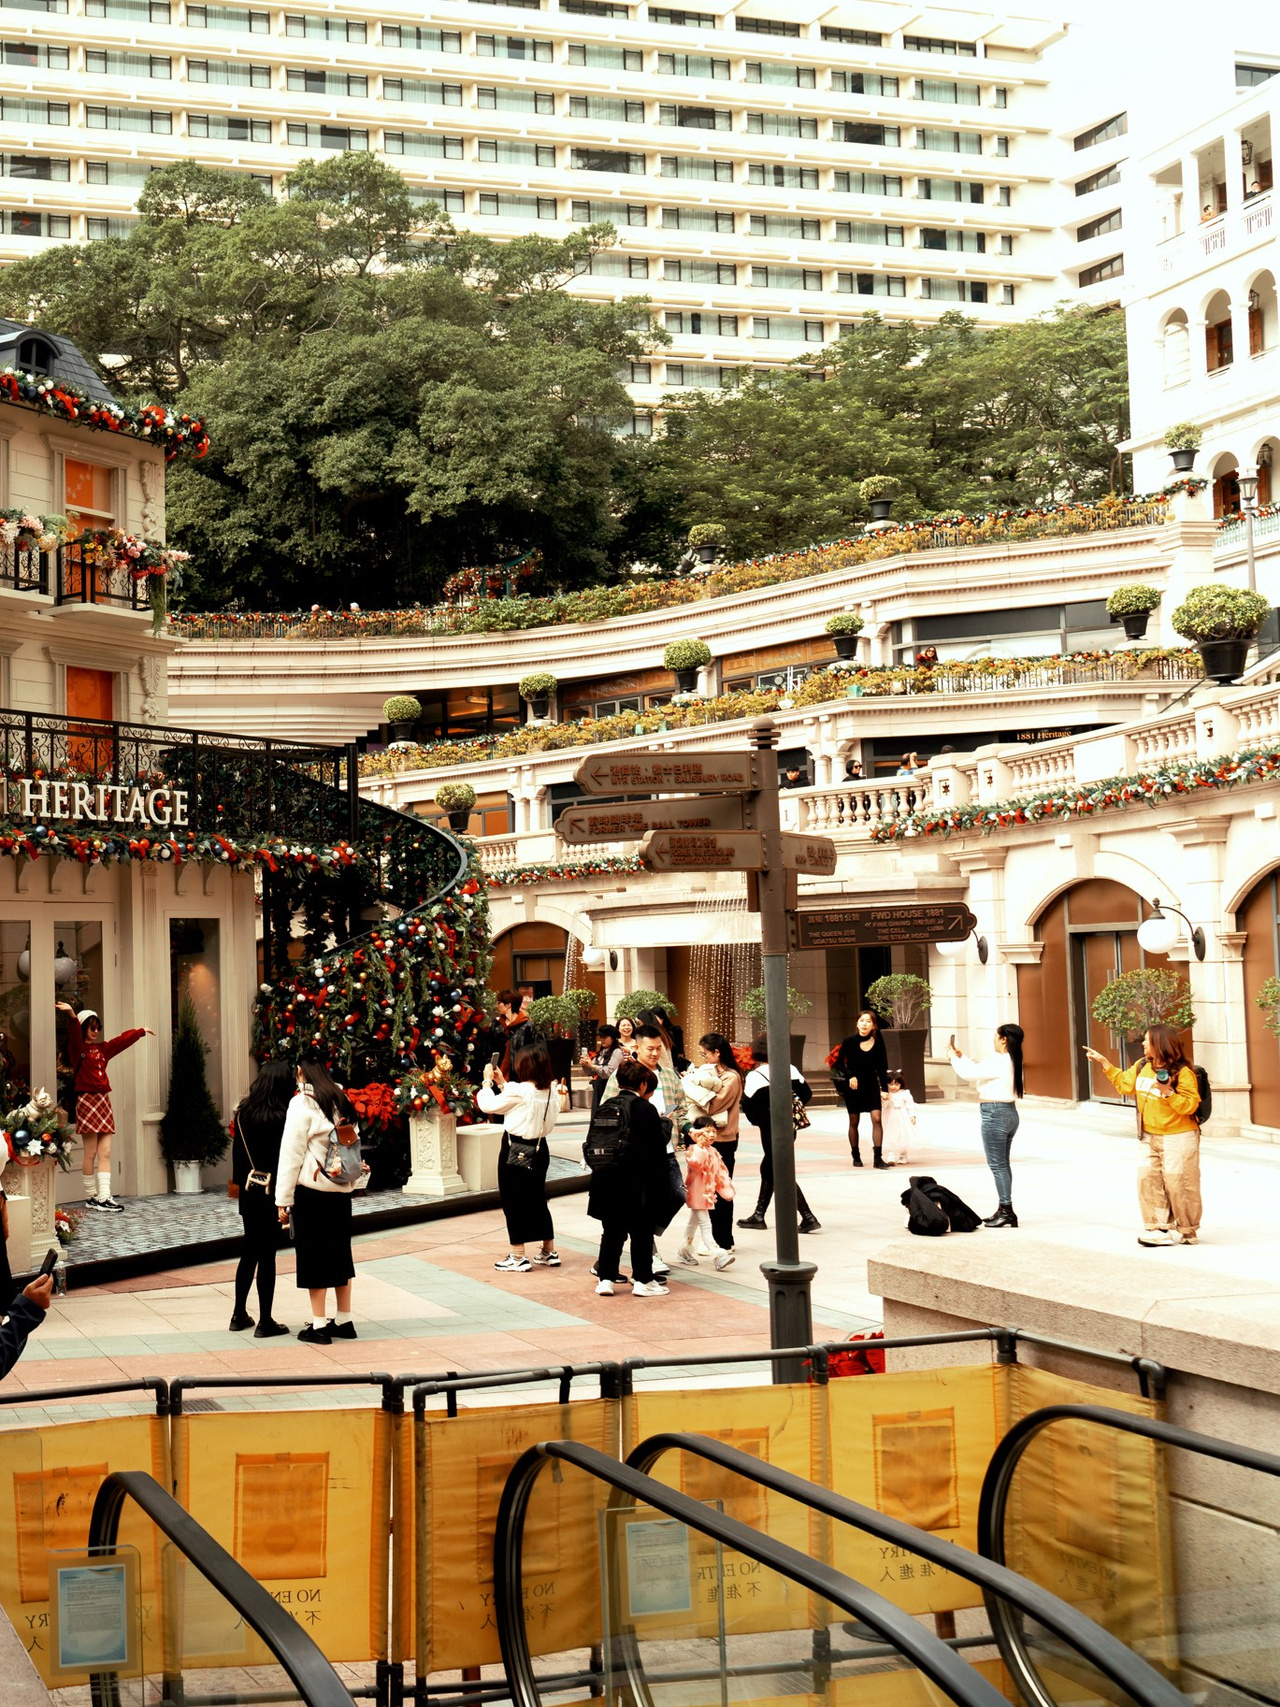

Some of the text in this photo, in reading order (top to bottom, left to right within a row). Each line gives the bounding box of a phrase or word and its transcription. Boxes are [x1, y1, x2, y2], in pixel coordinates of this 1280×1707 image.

[1016, 732, 1035, 741] 1881
[611, 772, 744, 785] MTR STATION SALISBURY ROAD
[19, 778, 189, 826] HERITAGE
[589, 817, 710, 836] FORMER TIME BALL TOWER
[871, 908, 945, 920] FWD HOUSE 1881
